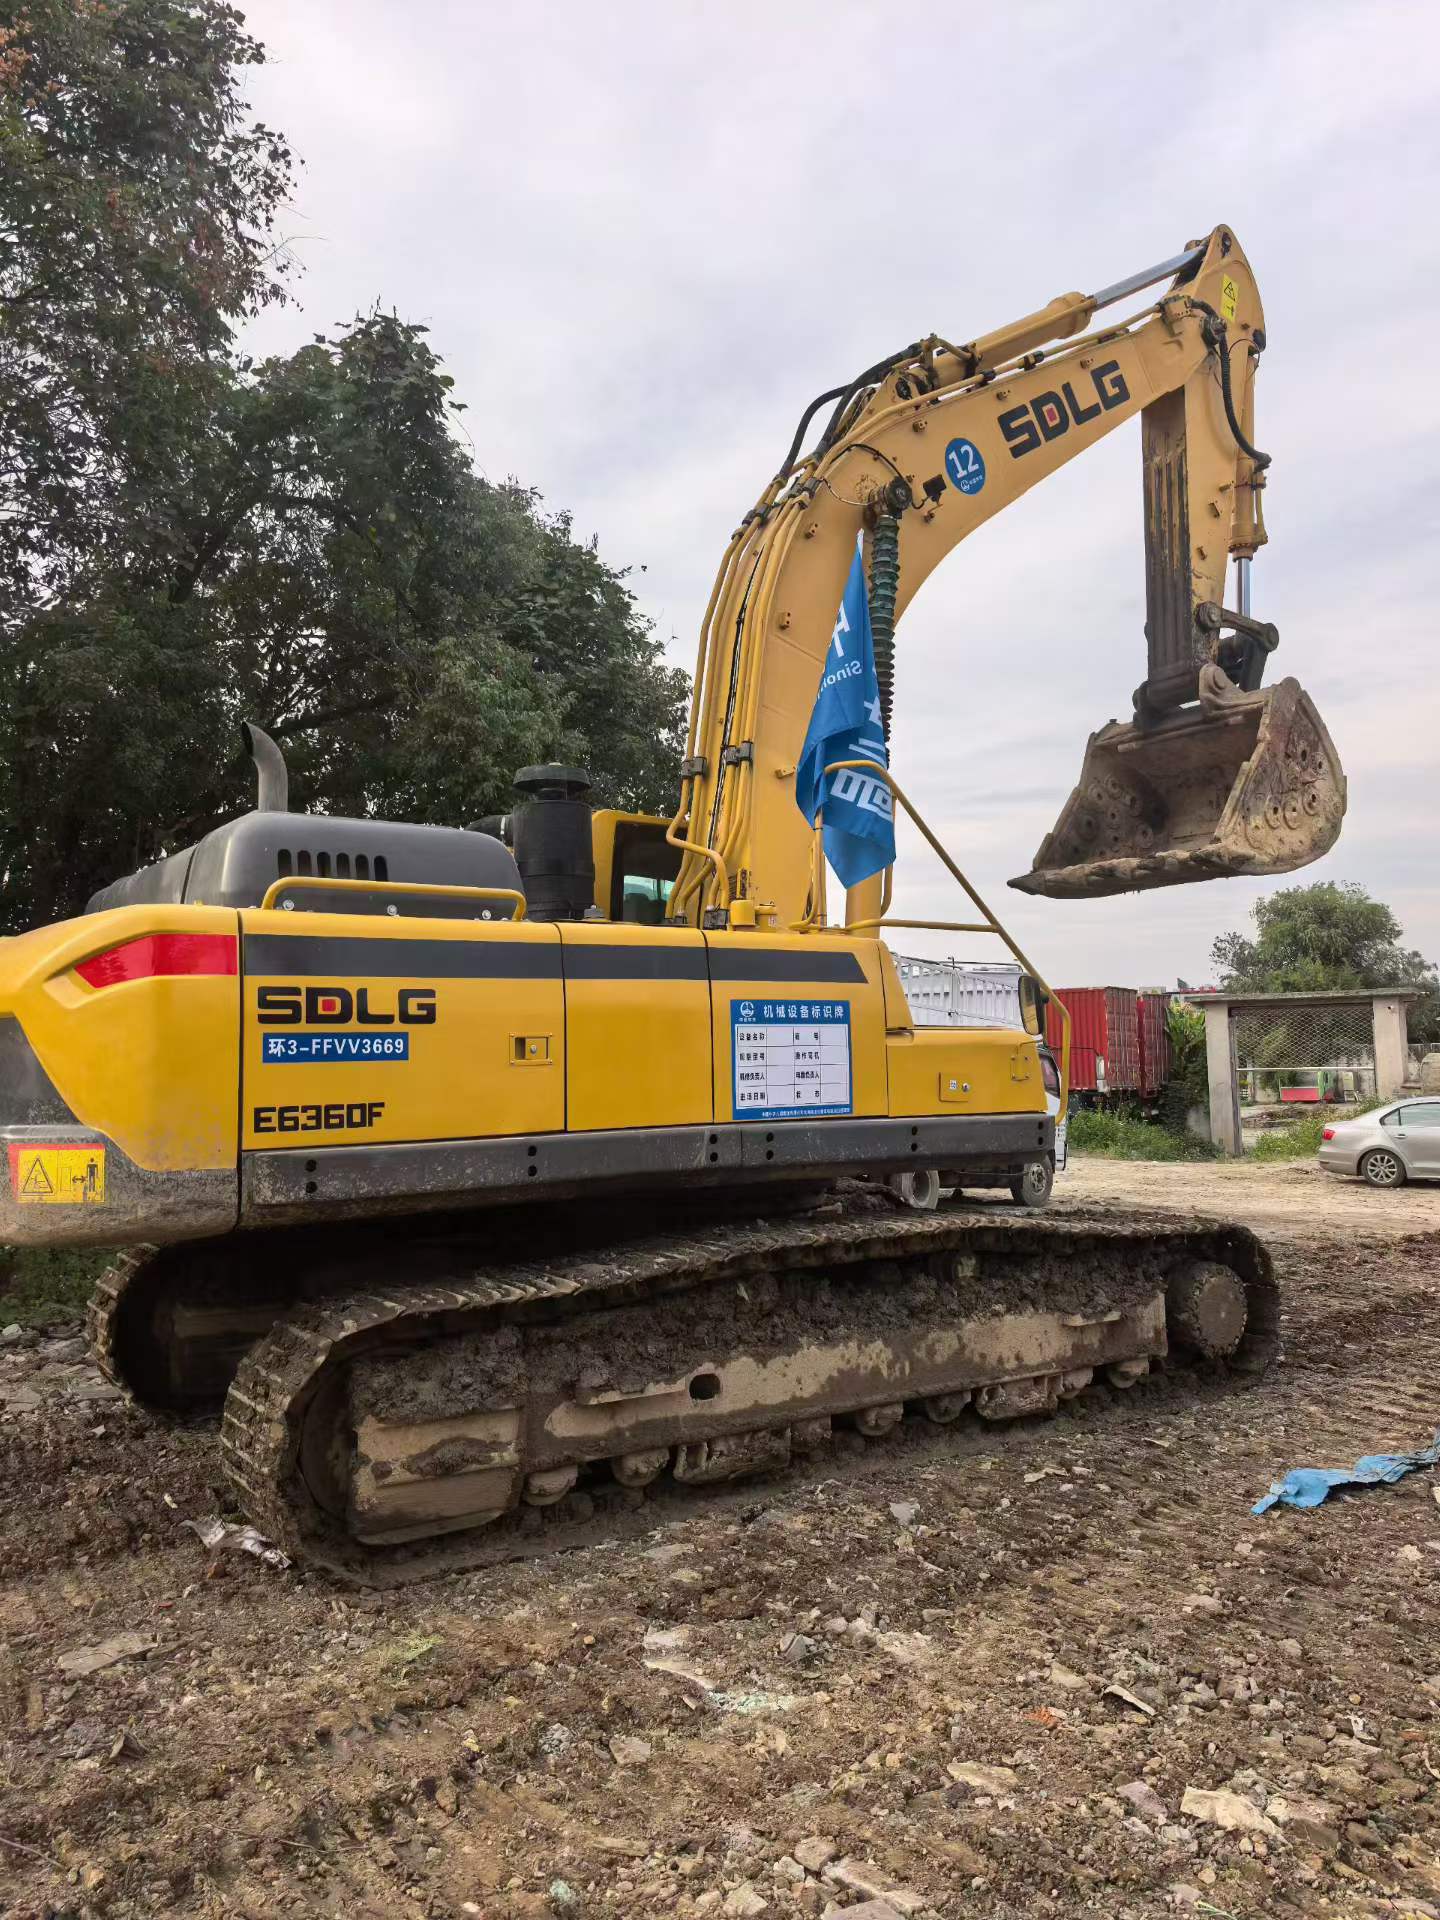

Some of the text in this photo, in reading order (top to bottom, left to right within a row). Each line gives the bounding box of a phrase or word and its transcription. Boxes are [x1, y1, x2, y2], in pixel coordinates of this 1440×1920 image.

[997, 360, 1130, 459] SDLG
[949, 445, 979, 479] 12
[257, 986, 436, 1024] SDLG
[763, 1004, 845, 1019] 机械设备标识牌
[268, 1038, 404, 1057] 环3-FFVV3669
[254, 1102, 385, 1133] E6360F
